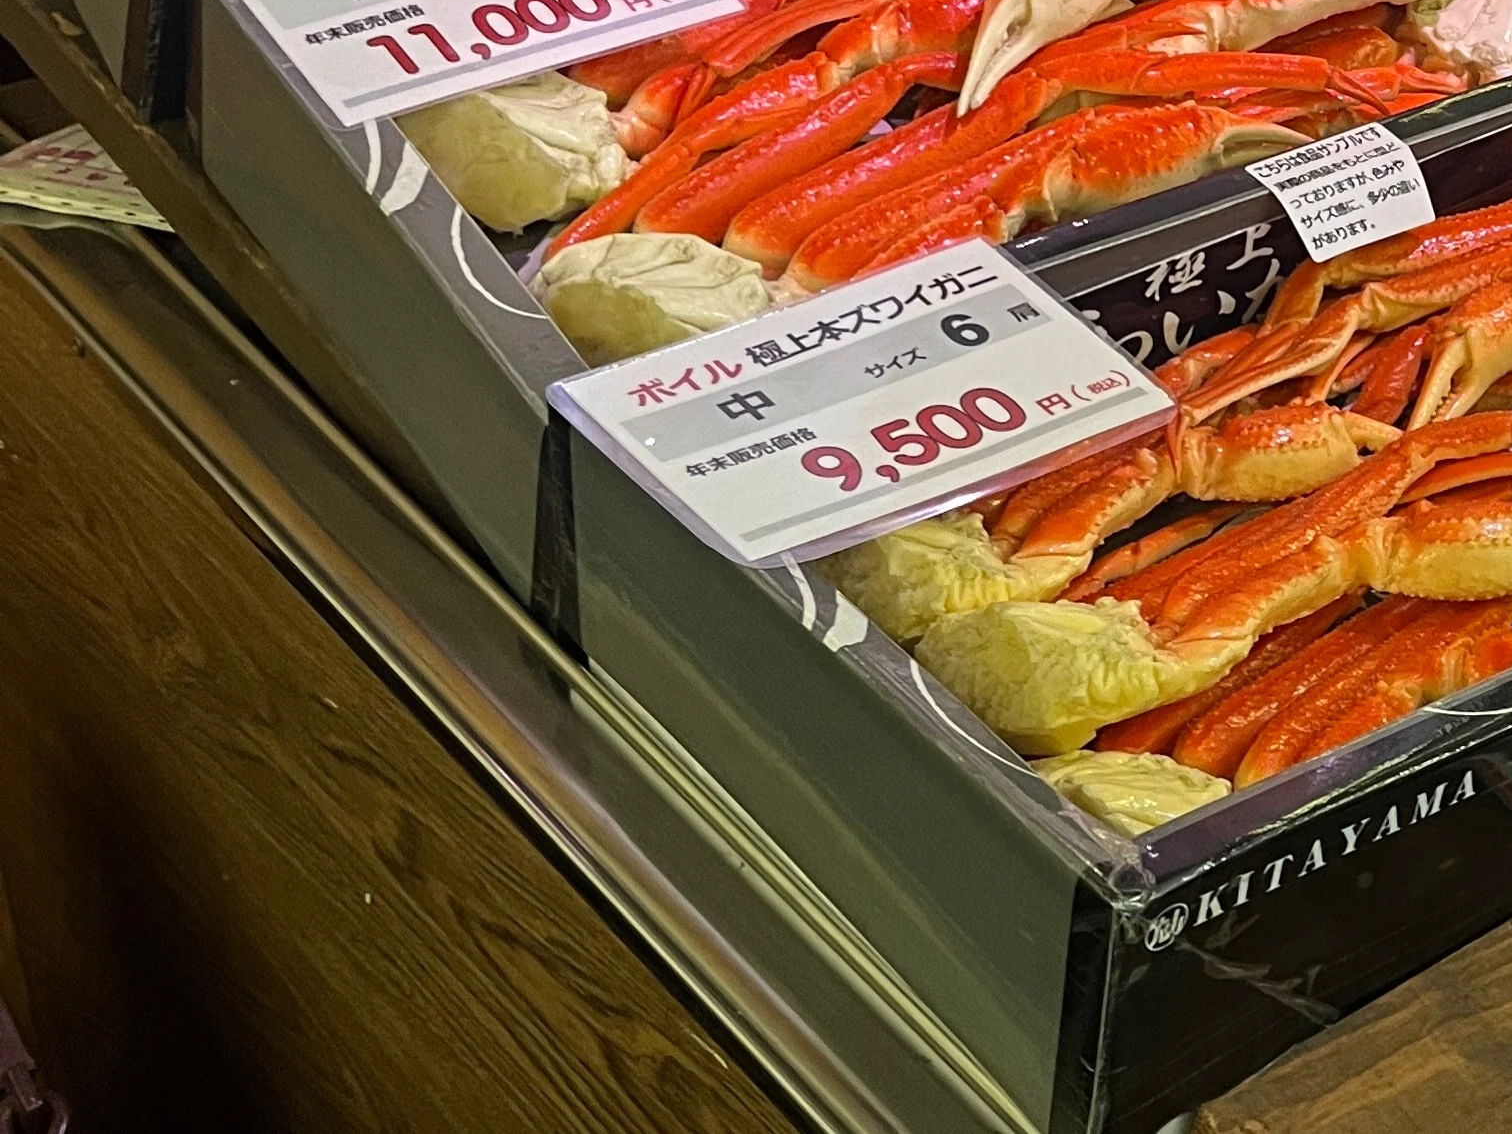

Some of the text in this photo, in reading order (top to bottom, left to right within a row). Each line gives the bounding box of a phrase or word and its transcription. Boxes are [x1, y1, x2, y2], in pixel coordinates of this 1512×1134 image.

[1144, 222, 1275, 302] 極上
[1311, 218, 1377, 250] があります。
[627, 358, 743, 409] ボイル
[744, 265, 999, 369] 極上本ズワイガニ
[716, 301, 1042, 422] 中 サイズ 6 肩
[685, 426, 819, 480] 年末販売価格
[799, 386, 1028, 493] 9,500
[1192, 768, 1481, 929] KITAYAMA
